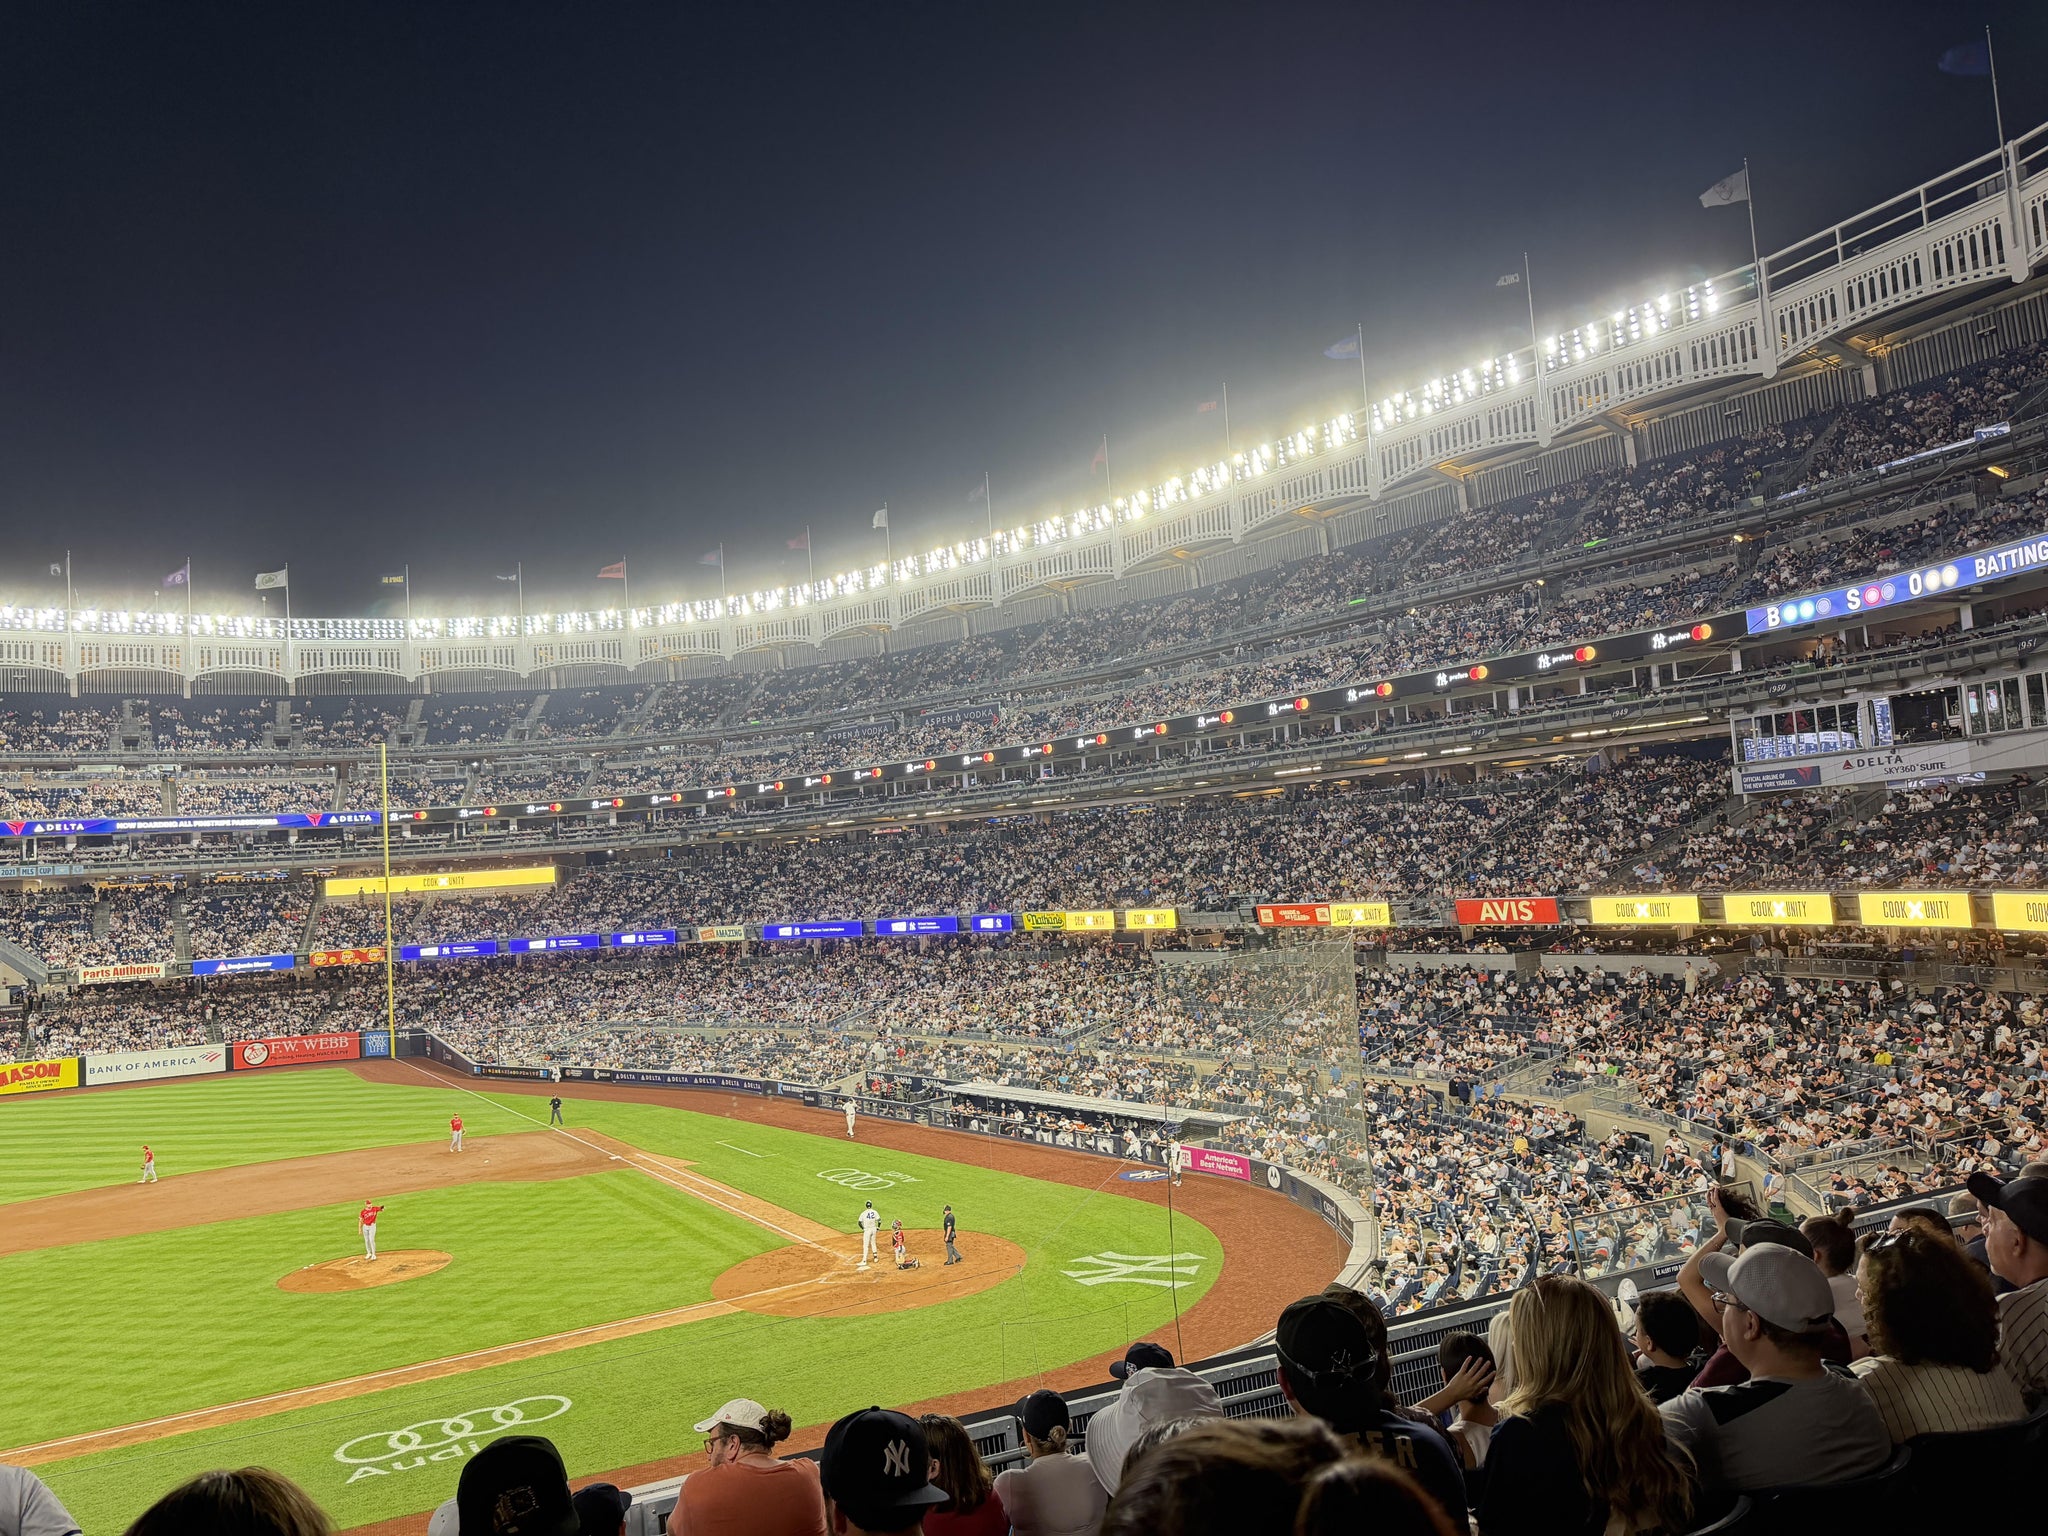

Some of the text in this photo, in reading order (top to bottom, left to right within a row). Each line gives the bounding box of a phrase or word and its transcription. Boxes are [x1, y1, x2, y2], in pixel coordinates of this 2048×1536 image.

[1767, 606, 1781, 628] B
[1846, 588, 1861, 611] S
[1974, 541, 2048, 578] BATTING
[1769, 682, 1786, 695] 1950
[925, 708, 994, 727] ASPEN VODKA
[1612, 707, 1628, 719] 1949
[861, 725, 889, 737] VODKA
[1856, 755, 1903, 768] DELTA
[1919, 761, 1947, 772] SUITE
[1742, 775, 1762, 783] OFFICIAL
[116, 822, 136, 830] NOW
[178, 819, 193, 828] ALL
[339, 814, 373, 824] DELTA
[46, 823, 85, 832] DELTA
[22, 867, 35, 876] MLS
[39, 866, 52, 875] CUP
[1479, 900, 1534, 922] AVIS
[716, 929, 743, 938] AMAZING
[83, 964, 161, 979] Parts Authority
[271, 1041, 299, 1054] F.W.
[301, 1036, 349, 1051] WEBB
[89, 1057, 197, 1075] BANK OF AMERICA
[697, 1077, 717, 1085] DELTA
[726, 1080, 740, 1088] DELTA
[748, 1081, 762, 1090] DELTA
[1204, 1153, 1239, 1166] America's
[1199, 1159, 1244, 1175] Best Network
[866, 1211, 876, 1220] 42
